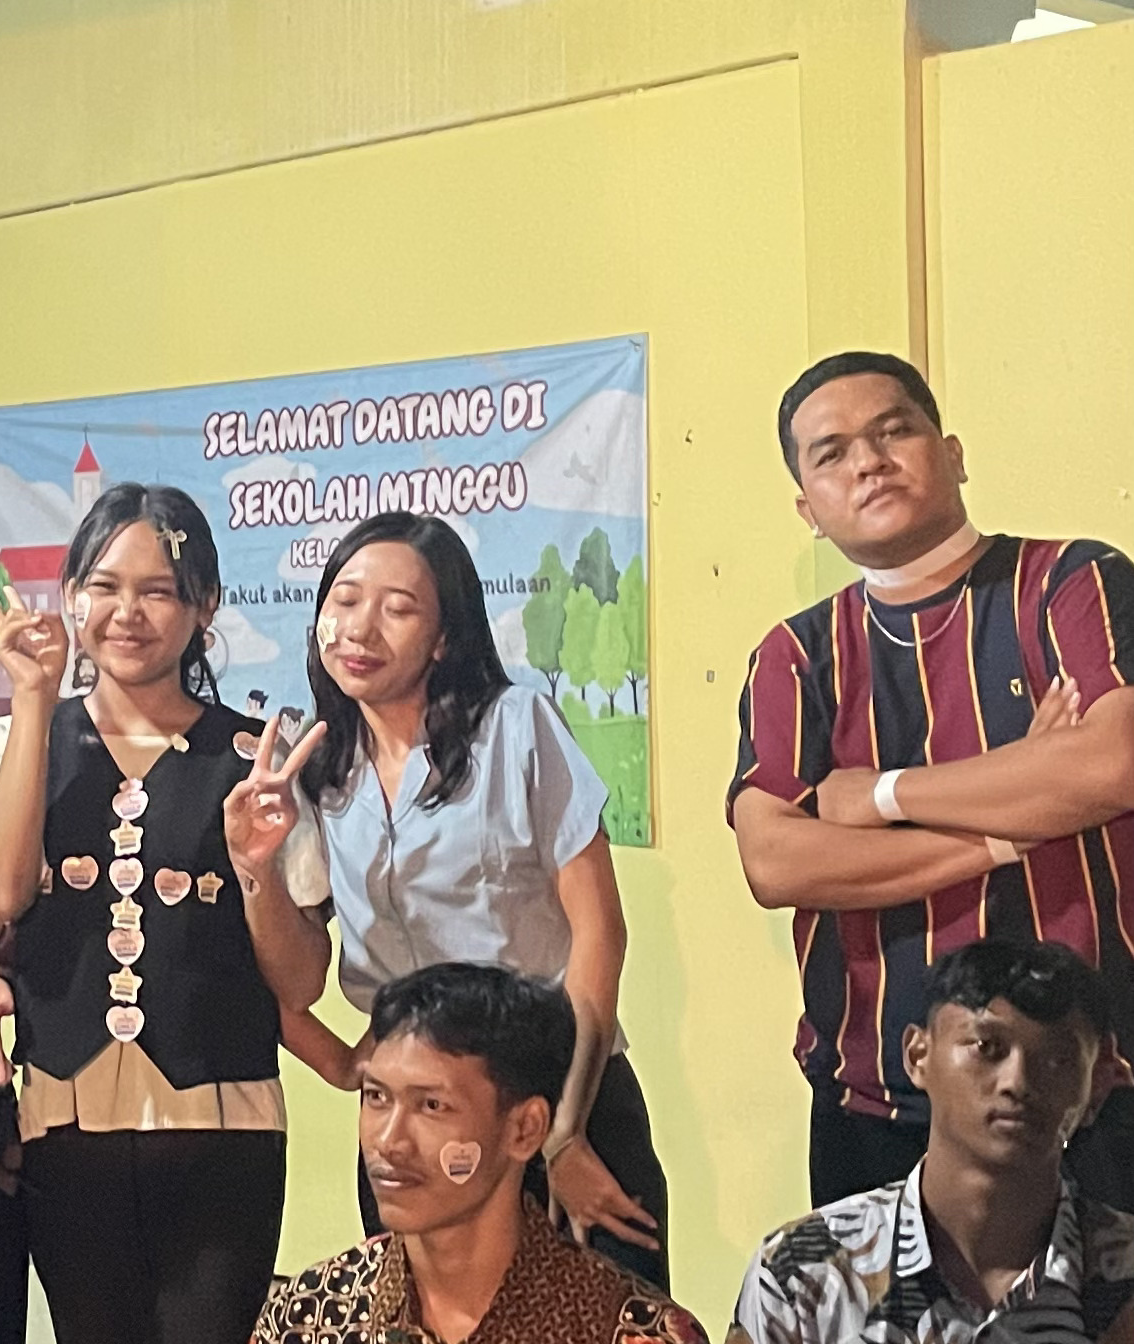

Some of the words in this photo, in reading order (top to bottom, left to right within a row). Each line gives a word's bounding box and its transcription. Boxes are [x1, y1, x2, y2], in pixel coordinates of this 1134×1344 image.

[204, 400, 350, 461] SELAMAT
[352, 386, 496, 446] DATANG
[501, 379, 548, 432] DI
[229, 473, 370, 530] SEKOLAH
[377, 461, 528, 515] MINGGU
[272, 582, 315, 605] akan
[481, 571, 551, 595] mulaan
